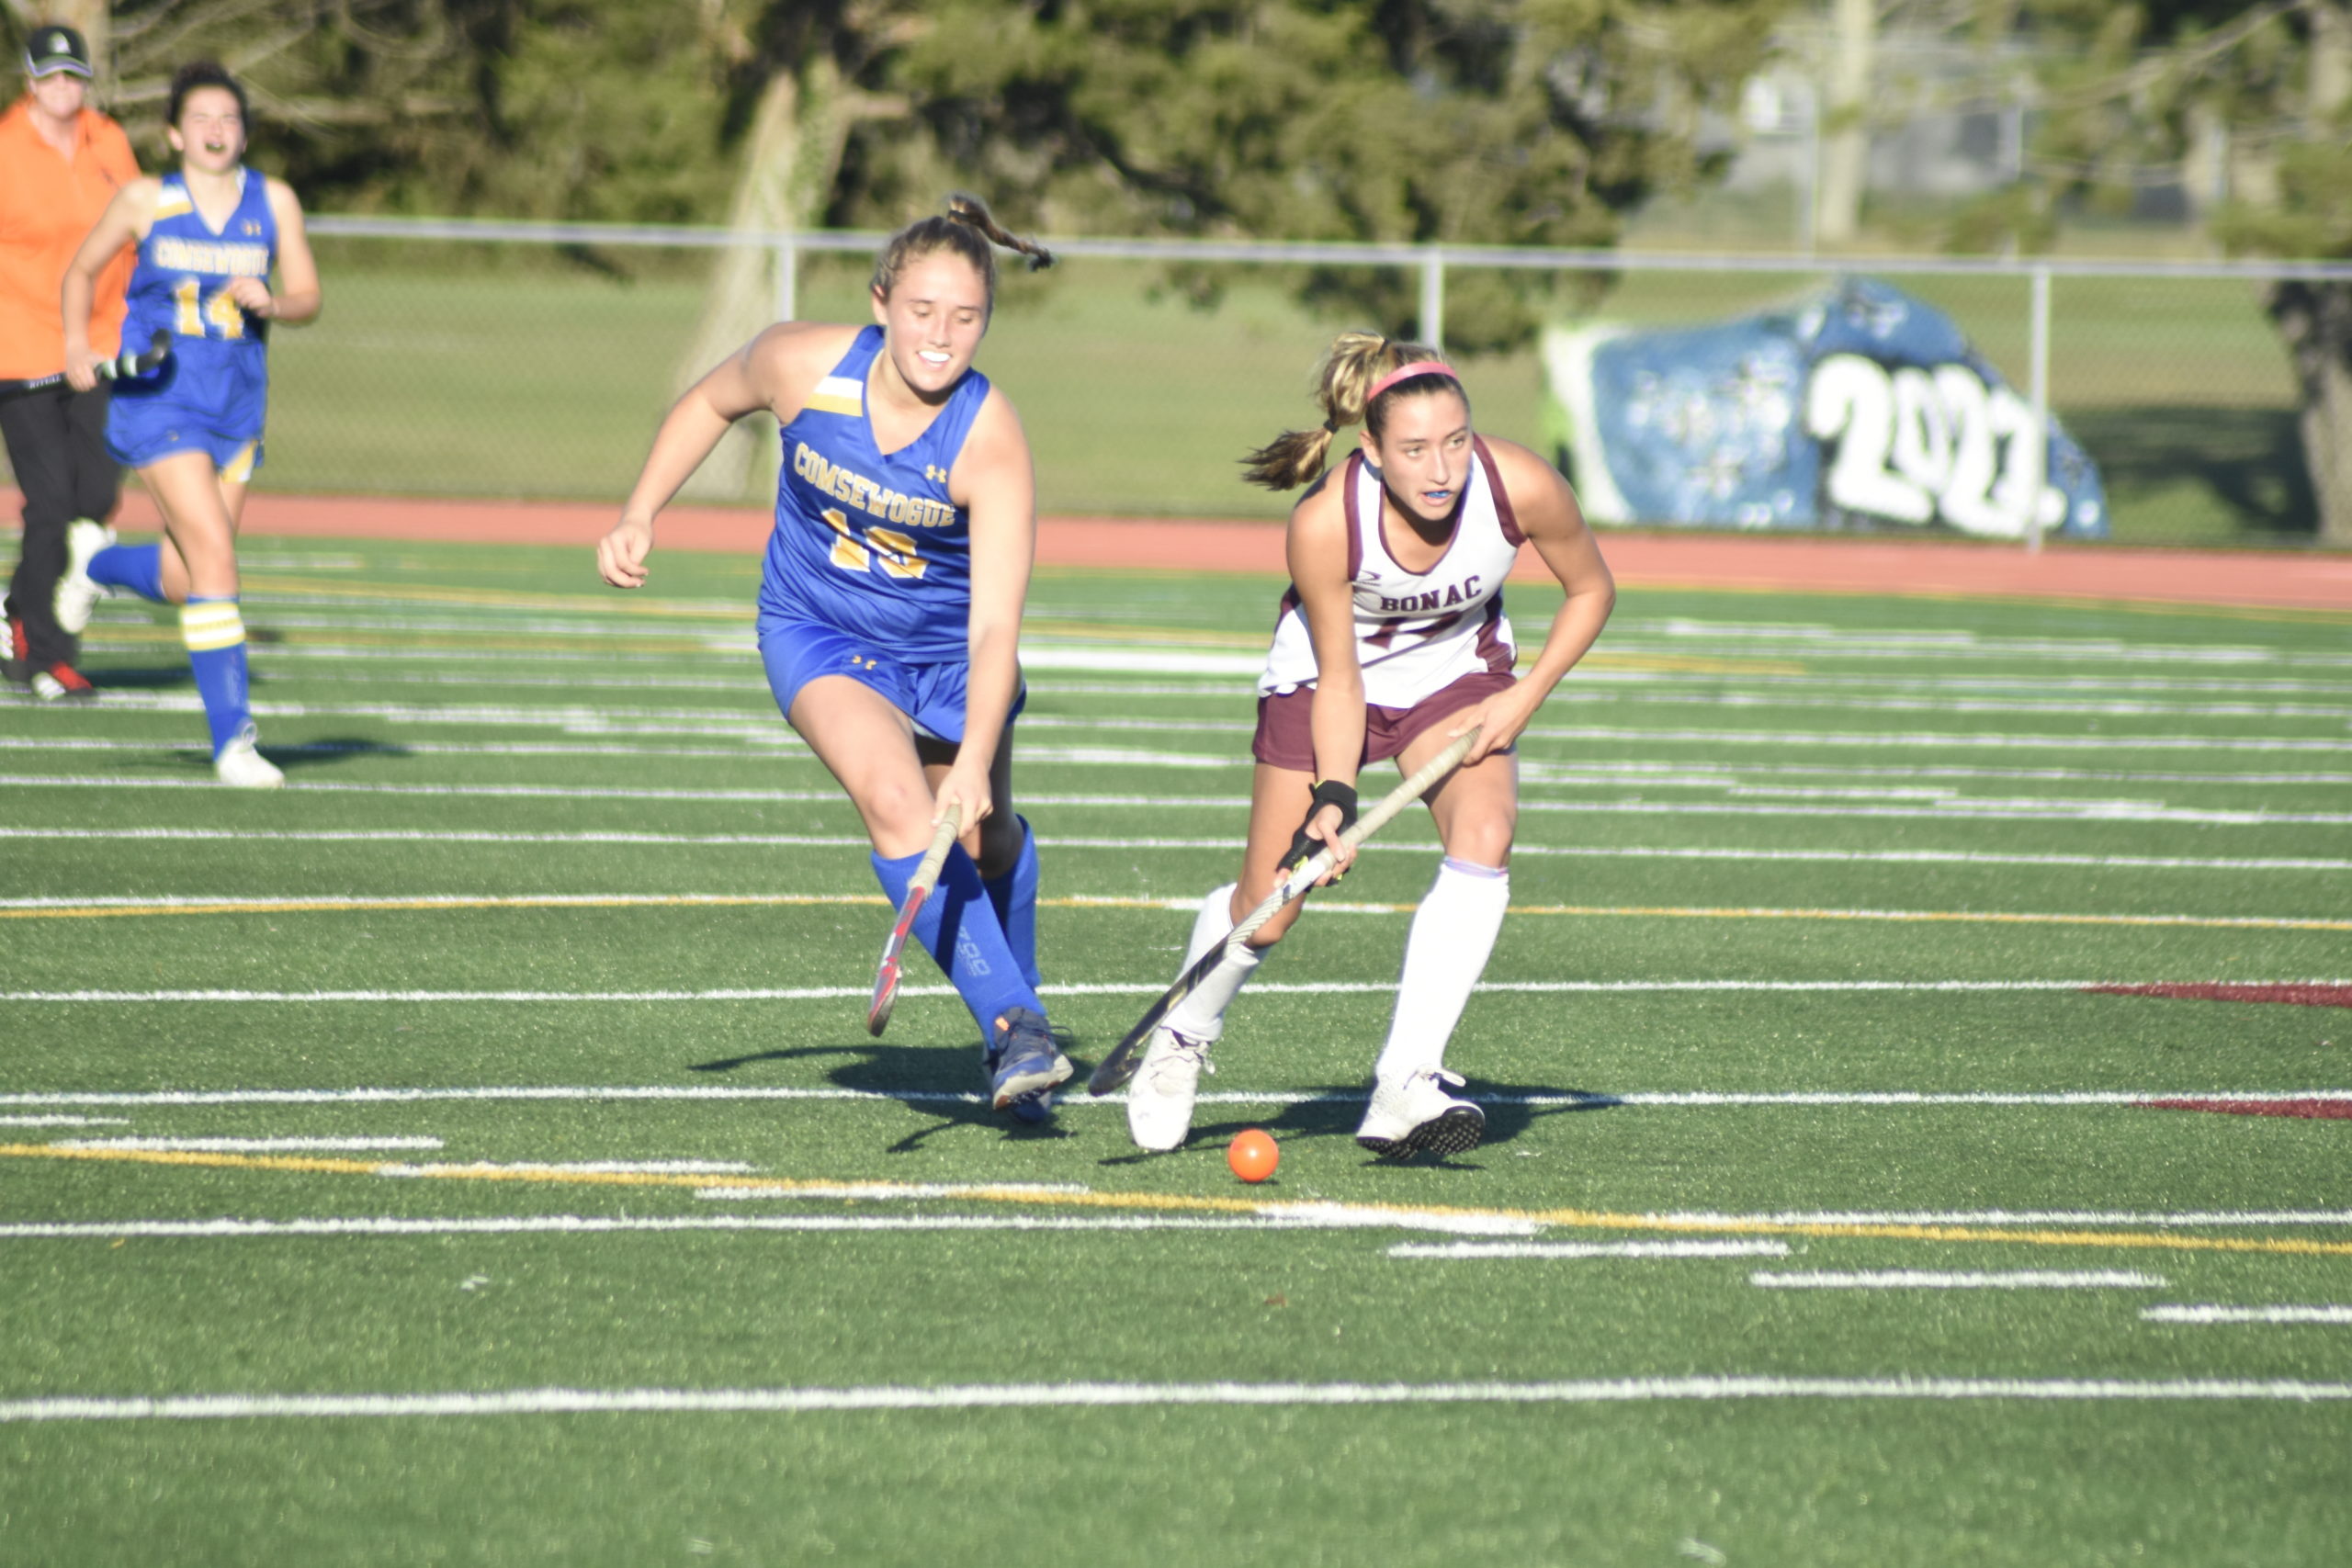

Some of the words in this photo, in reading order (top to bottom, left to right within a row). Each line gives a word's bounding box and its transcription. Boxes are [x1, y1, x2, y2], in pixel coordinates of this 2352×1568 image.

[175, 279, 245, 339] 14
[793, 441, 956, 527] COMSEWOGUE
[1380, 574, 1482, 612] BONAC
